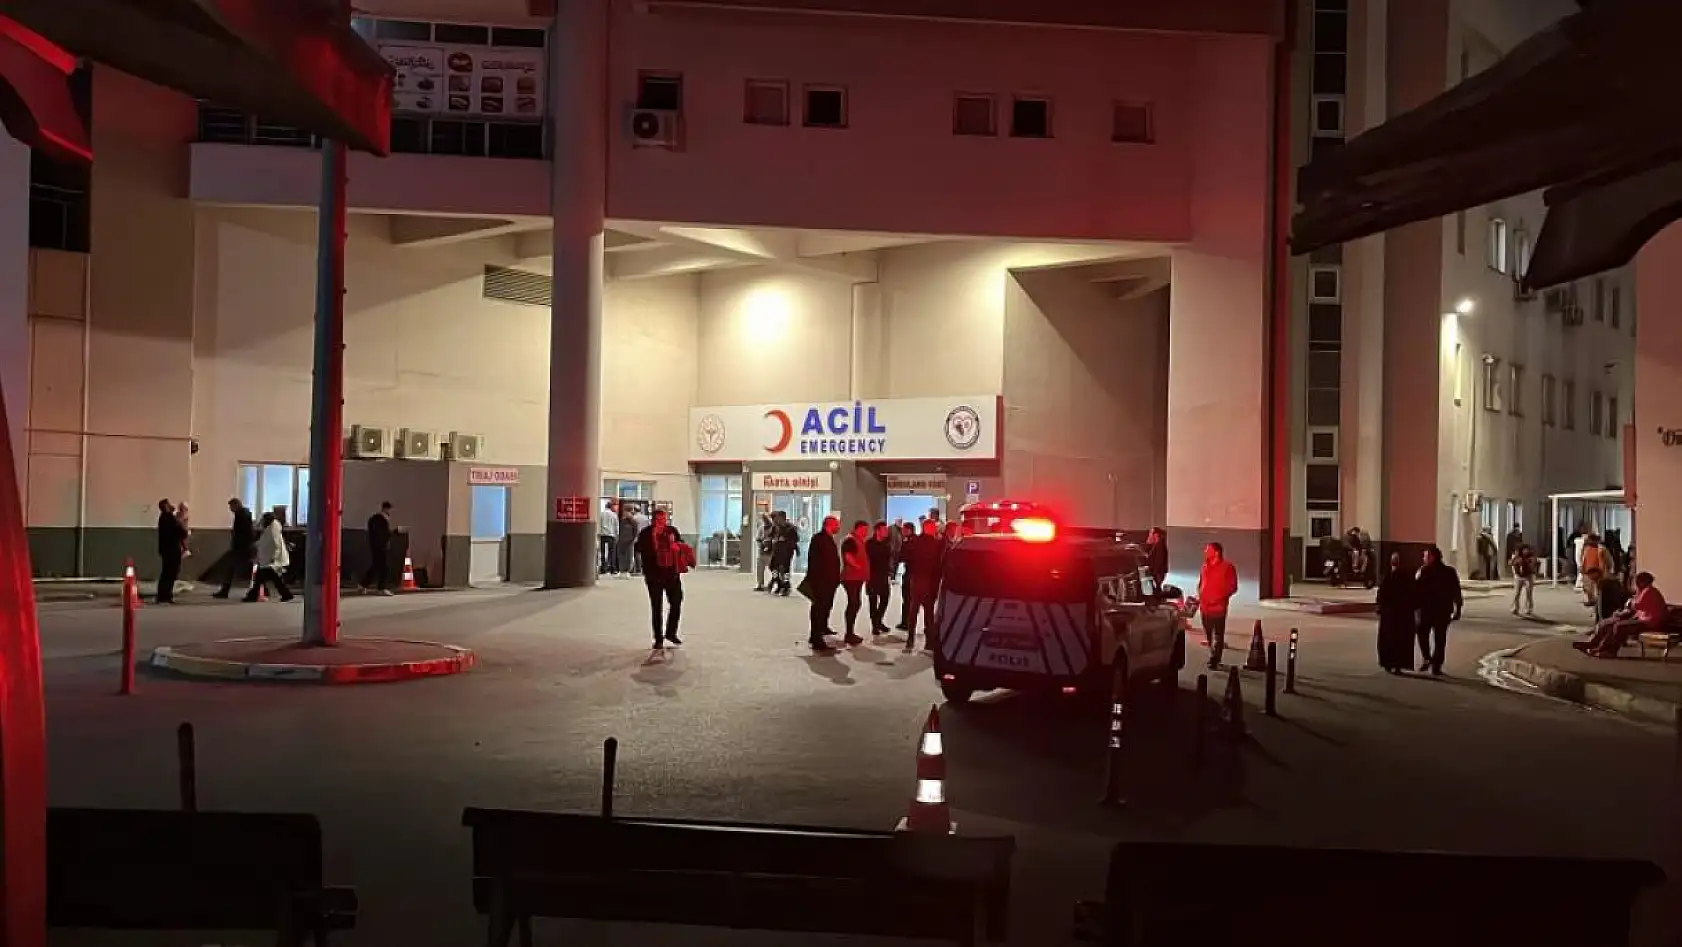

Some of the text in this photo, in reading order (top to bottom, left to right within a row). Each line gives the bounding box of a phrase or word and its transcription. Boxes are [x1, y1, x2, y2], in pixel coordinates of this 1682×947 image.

[801, 400, 886, 435] ACİL
[801, 439, 886, 454] EMERGENCY
[969, 482, 978, 494] P
